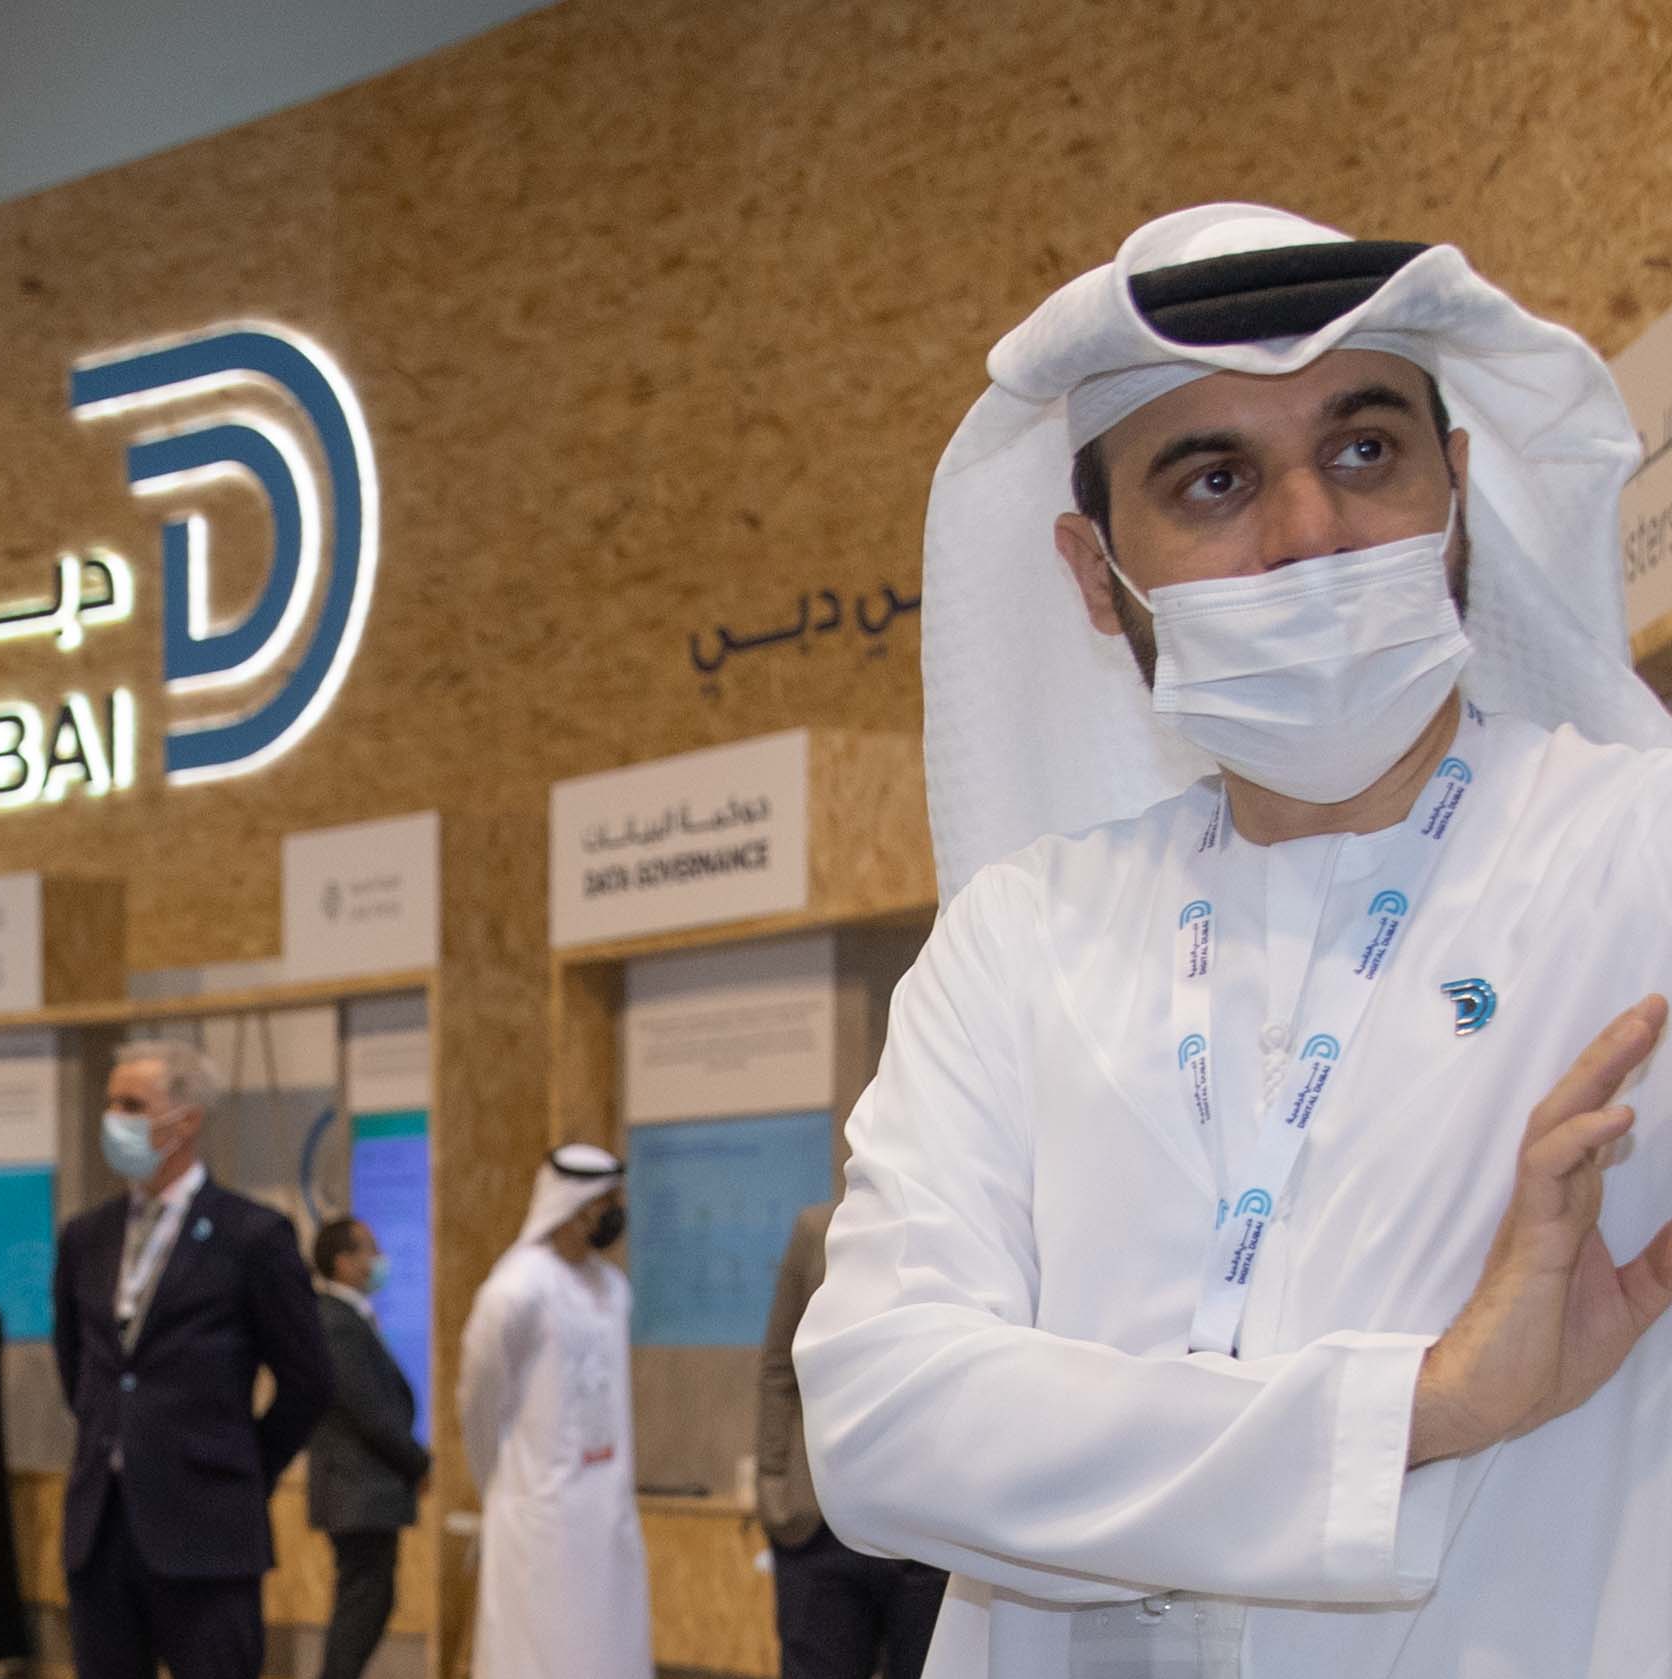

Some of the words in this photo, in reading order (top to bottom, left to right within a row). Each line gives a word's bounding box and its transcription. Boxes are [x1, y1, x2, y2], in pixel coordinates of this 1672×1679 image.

[1296, 1095, 1319, 1129] DIGITAL
[1313, 1065, 1331, 1093] DUBAI
[1238, 1253, 1255, 1284] DIGITAL
[1249, 1221, 1264, 1250] DUBAI
